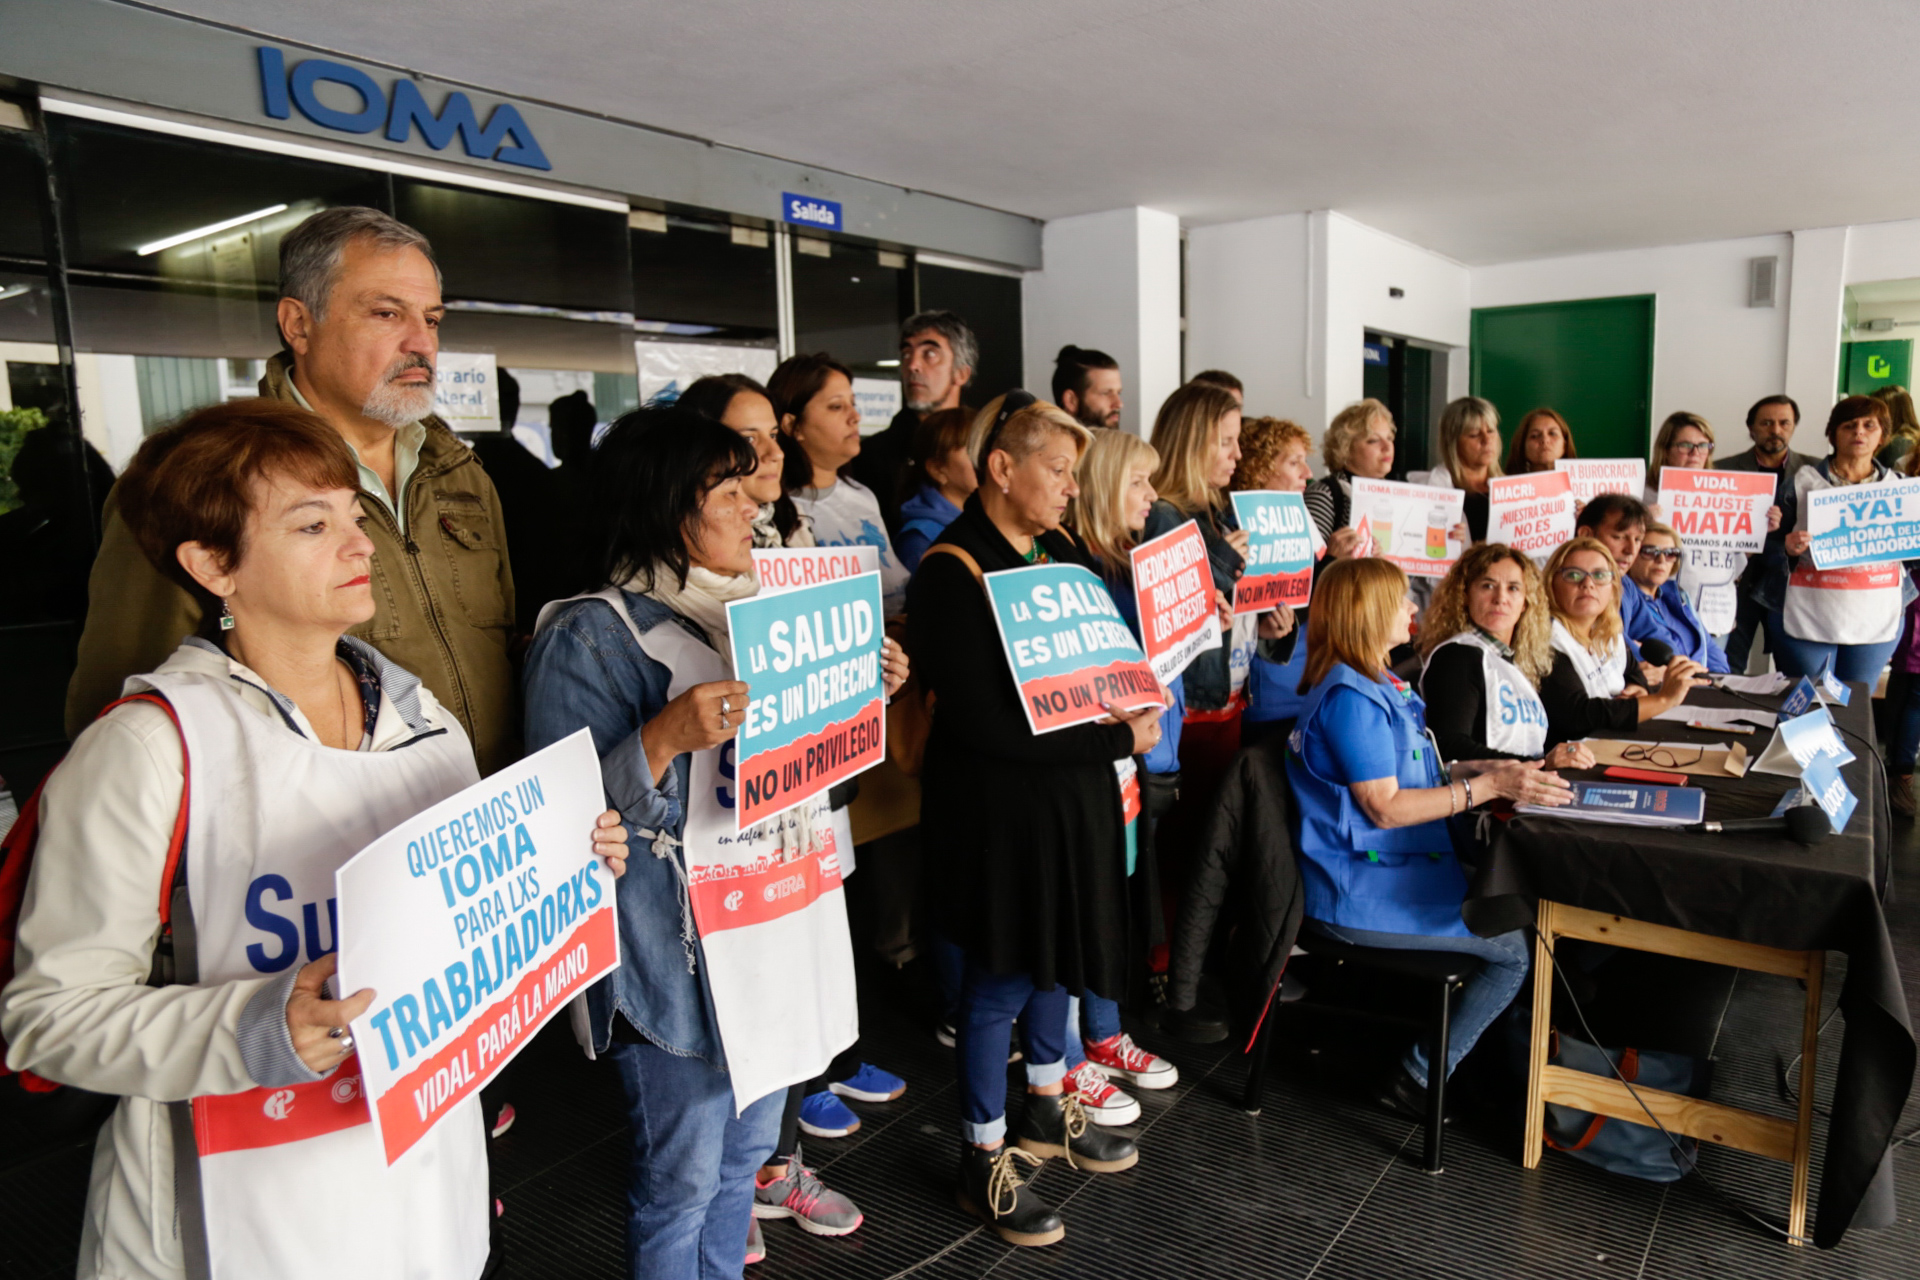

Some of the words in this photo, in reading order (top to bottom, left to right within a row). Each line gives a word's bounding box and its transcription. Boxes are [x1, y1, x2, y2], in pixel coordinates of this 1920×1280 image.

[258, 46, 552, 171] IOMA
[791, 200, 835, 225] Salida
[1579, 464, 1637, 479] BUROCRACIA
[1692, 475, 1738, 491] VIDAL
[1367, 485, 1391, 495] IOMA
[1493, 483, 1536, 501] MACRI:
[1571, 482, 1590, 497] DEL
[1592, 481, 1631, 496] IOMA
[1673, 494, 1689, 507] EL
[1692, 496, 1754, 512] AJUSTE
[1256, 505, 1306, 536] SALUD
[1500, 505, 1539, 529] ¡NUESTRA
[1540, 499, 1566, 516] SALUD
[1513, 523, 1533, 538] NO
[1535, 518, 1551, 533] ES
[1671, 511, 1753, 535] MATA
[1839, 497, 1903, 528] ¡YA!
[1258, 543, 1273, 565] UN
[1272, 537, 1311, 564] DERECHO
[1722, 538, 1734, 548] AL
[1735, 541, 1759, 549] IOMA
[1834, 535, 1848, 547] UN
[1849, 525, 1896, 544] IOMA
[1898, 525, 1911, 536] DE
[1136, 533, 1204, 592] MEDICAMENTOS
[1010, 601, 1033, 622] LA
[1030, 581, 1120, 622] SALUD
[1152, 578, 1179, 614] PARA
[1176, 565, 1202, 601] QUIEN
[1236, 586, 1252, 605] NO
[1253, 585, 1265, 602] UN
[1264, 576, 1311, 601] PRIVILEGIO
[1152, 612, 1173, 644] LOS
[1171, 589, 1208, 634] NECESITE
[749, 644, 768, 674] LA
[768, 599, 874, 674] SALUD
[1012, 636, 1052, 668] ES
[1052, 629, 1083, 659] UN
[1160, 654, 1177, 679] SALUD
[1177, 650, 1183, 664] ES
[1184, 642, 1192, 661] UN
[1191, 627, 1212, 654] DERECHO
[745, 694, 779, 739] ES
[781, 684, 804, 724] UN
[806, 650, 878, 715] DERECHO
[1031, 690, 1068, 718] NO
[1068, 683, 1094, 709] UN
[745, 769, 779, 811] NO
[783, 757, 802, 793] UN
[806, 716, 880, 783] PRIVILEGIO
[406, 790, 518, 878] QUEREMOS
[515, 774, 546, 816] UN
[438, 822, 538, 909] IOMA
[763, 872, 806, 903] CTERA
[453, 889, 508, 950] PARA
[507, 866, 541, 913] LXS
[370, 859, 603, 1072] TRABAJADORXS
[413, 1048, 477, 1123] VIDAL
[476, 995, 523, 1071] PARÁ
[523, 984, 543, 1027] LA
[544, 942, 589, 1005] MANO
